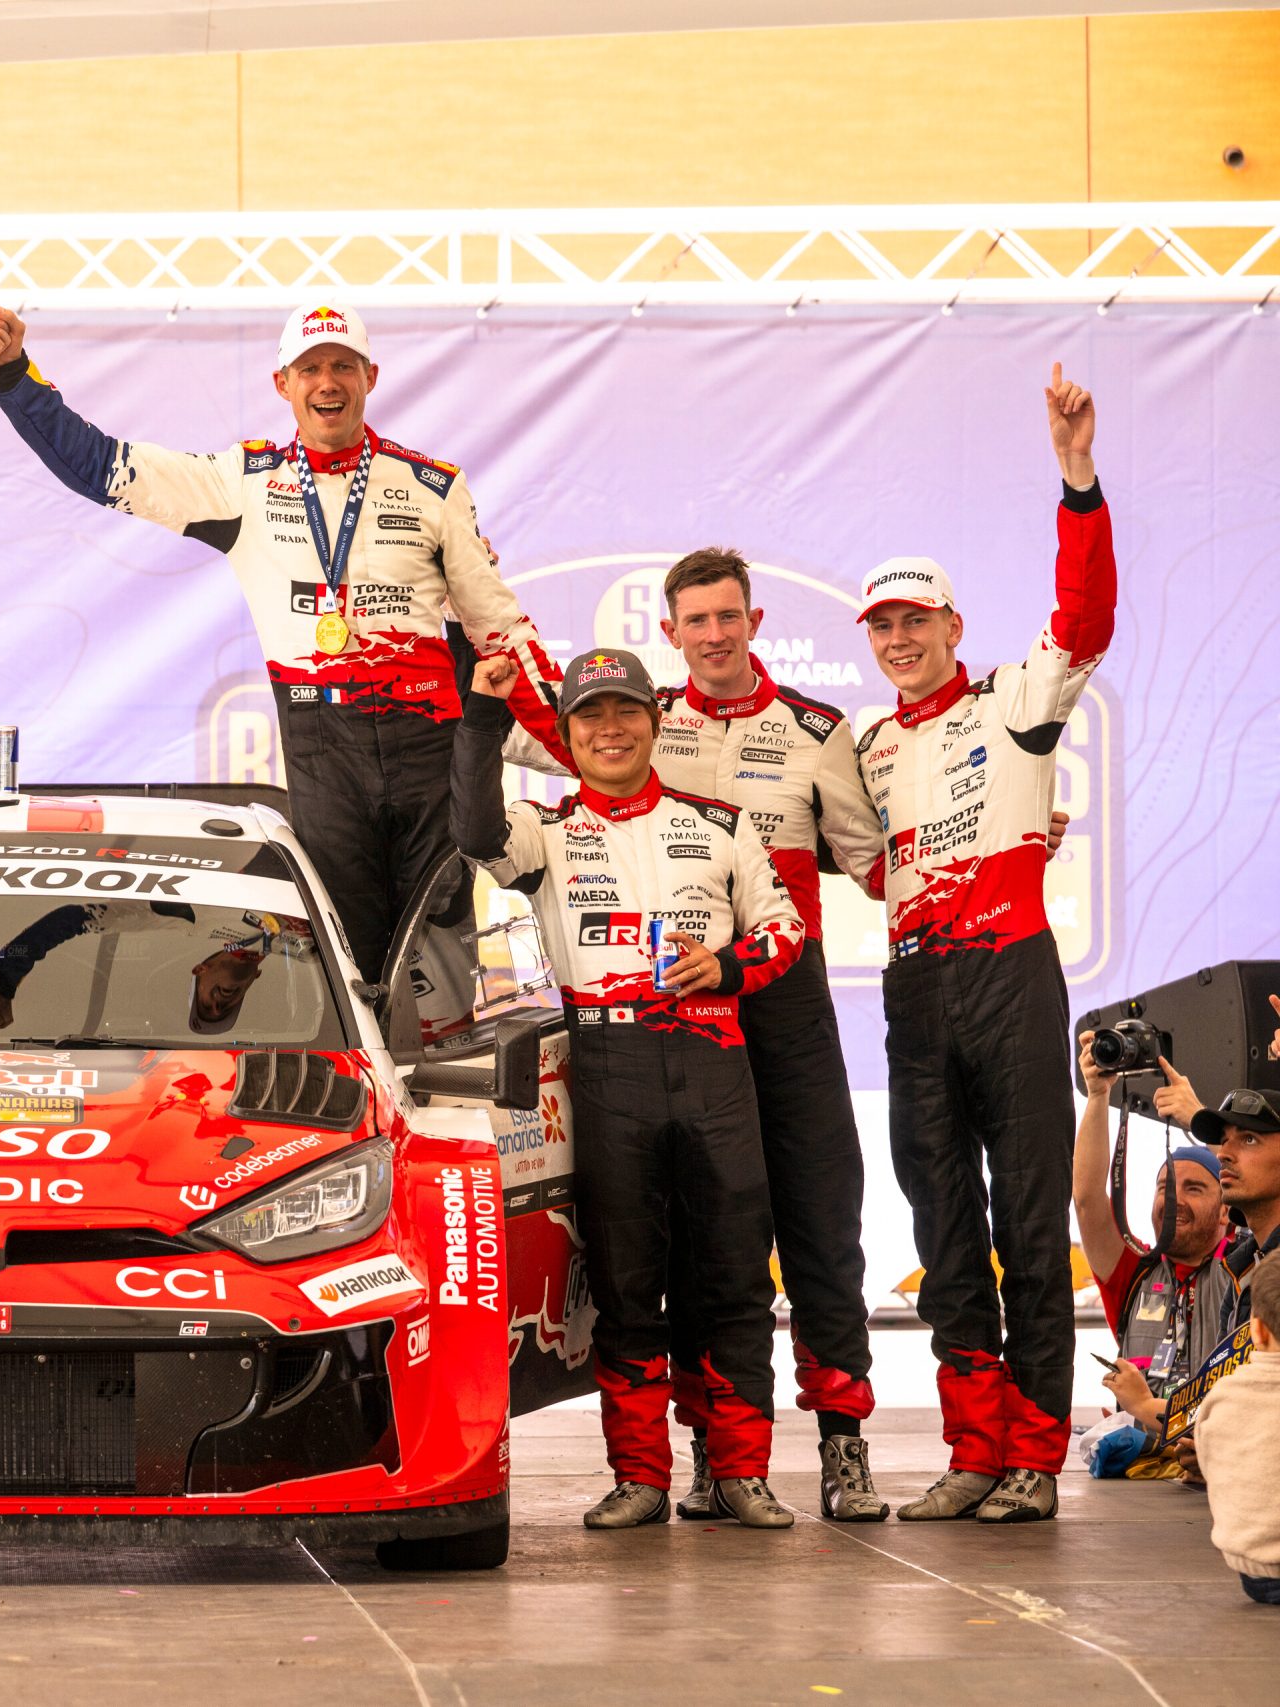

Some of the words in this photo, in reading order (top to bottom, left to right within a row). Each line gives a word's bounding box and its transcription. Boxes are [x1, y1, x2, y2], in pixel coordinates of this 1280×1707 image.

[302, 322, 324, 337] Red
[326, 321, 348, 335] Bull
[422, 469, 446, 485] OMP
[274, 534, 309, 544] PRADA
[353, 584, 415, 596] TOYOTA
[354, 595, 412, 607] GAZOO
[353, 604, 410, 618] Racing
[578, 670, 601, 685] Red
[602, 666, 627, 679] Bull
[290, 688, 318, 699] OMP
[405, 684, 414, 694] S.
[416, 680, 438, 693] OGIER
[717, 705, 736, 715] GR
[803, 712, 833, 732] OMP
[903, 712, 919, 723] GR
[662, 726, 698, 736] Panasonic
[660, 734, 699, 743] AUTOMOTIVE
[743, 734, 795, 748] TAMADIC
[740, 750, 786, 762] CENTRAL
[867, 744, 899, 764] DENSO
[735, 771, 755, 779] JDS
[610, 807, 628, 817] GR
[706, 809, 733, 824] OMP
[919, 801, 985, 834] TOYOTA
[563, 822, 606, 834] DENSO
[919, 816, 979, 847] GAZOO
[659, 832, 712, 842] TAMADIC
[919, 829, 977, 859] Racing
[96, 847, 222, 869] Racing
[667, 848, 711, 857] CENTRAL
[890, 843, 913, 870] GR
[568, 890, 620, 902] MAEDA
[965, 917, 975, 930] S.
[976, 901, 1011, 926] PAJARI
[581, 925, 639, 945] GR
[578, 1011, 601, 1022] OMP
[686, 1008, 694, 1017] T.
[696, 1007, 733, 1017] KATSUTA
[497, 1127, 544, 1156] anarias
[214, 1133, 323, 1190] codebeamer
[435, 1167, 469, 1306] Panasonic
[470, 1167, 498, 1312] AUTOMOTIVE
[182, 1326, 207, 1335] GR
[1170, 1377, 1203, 1413] RALLY
